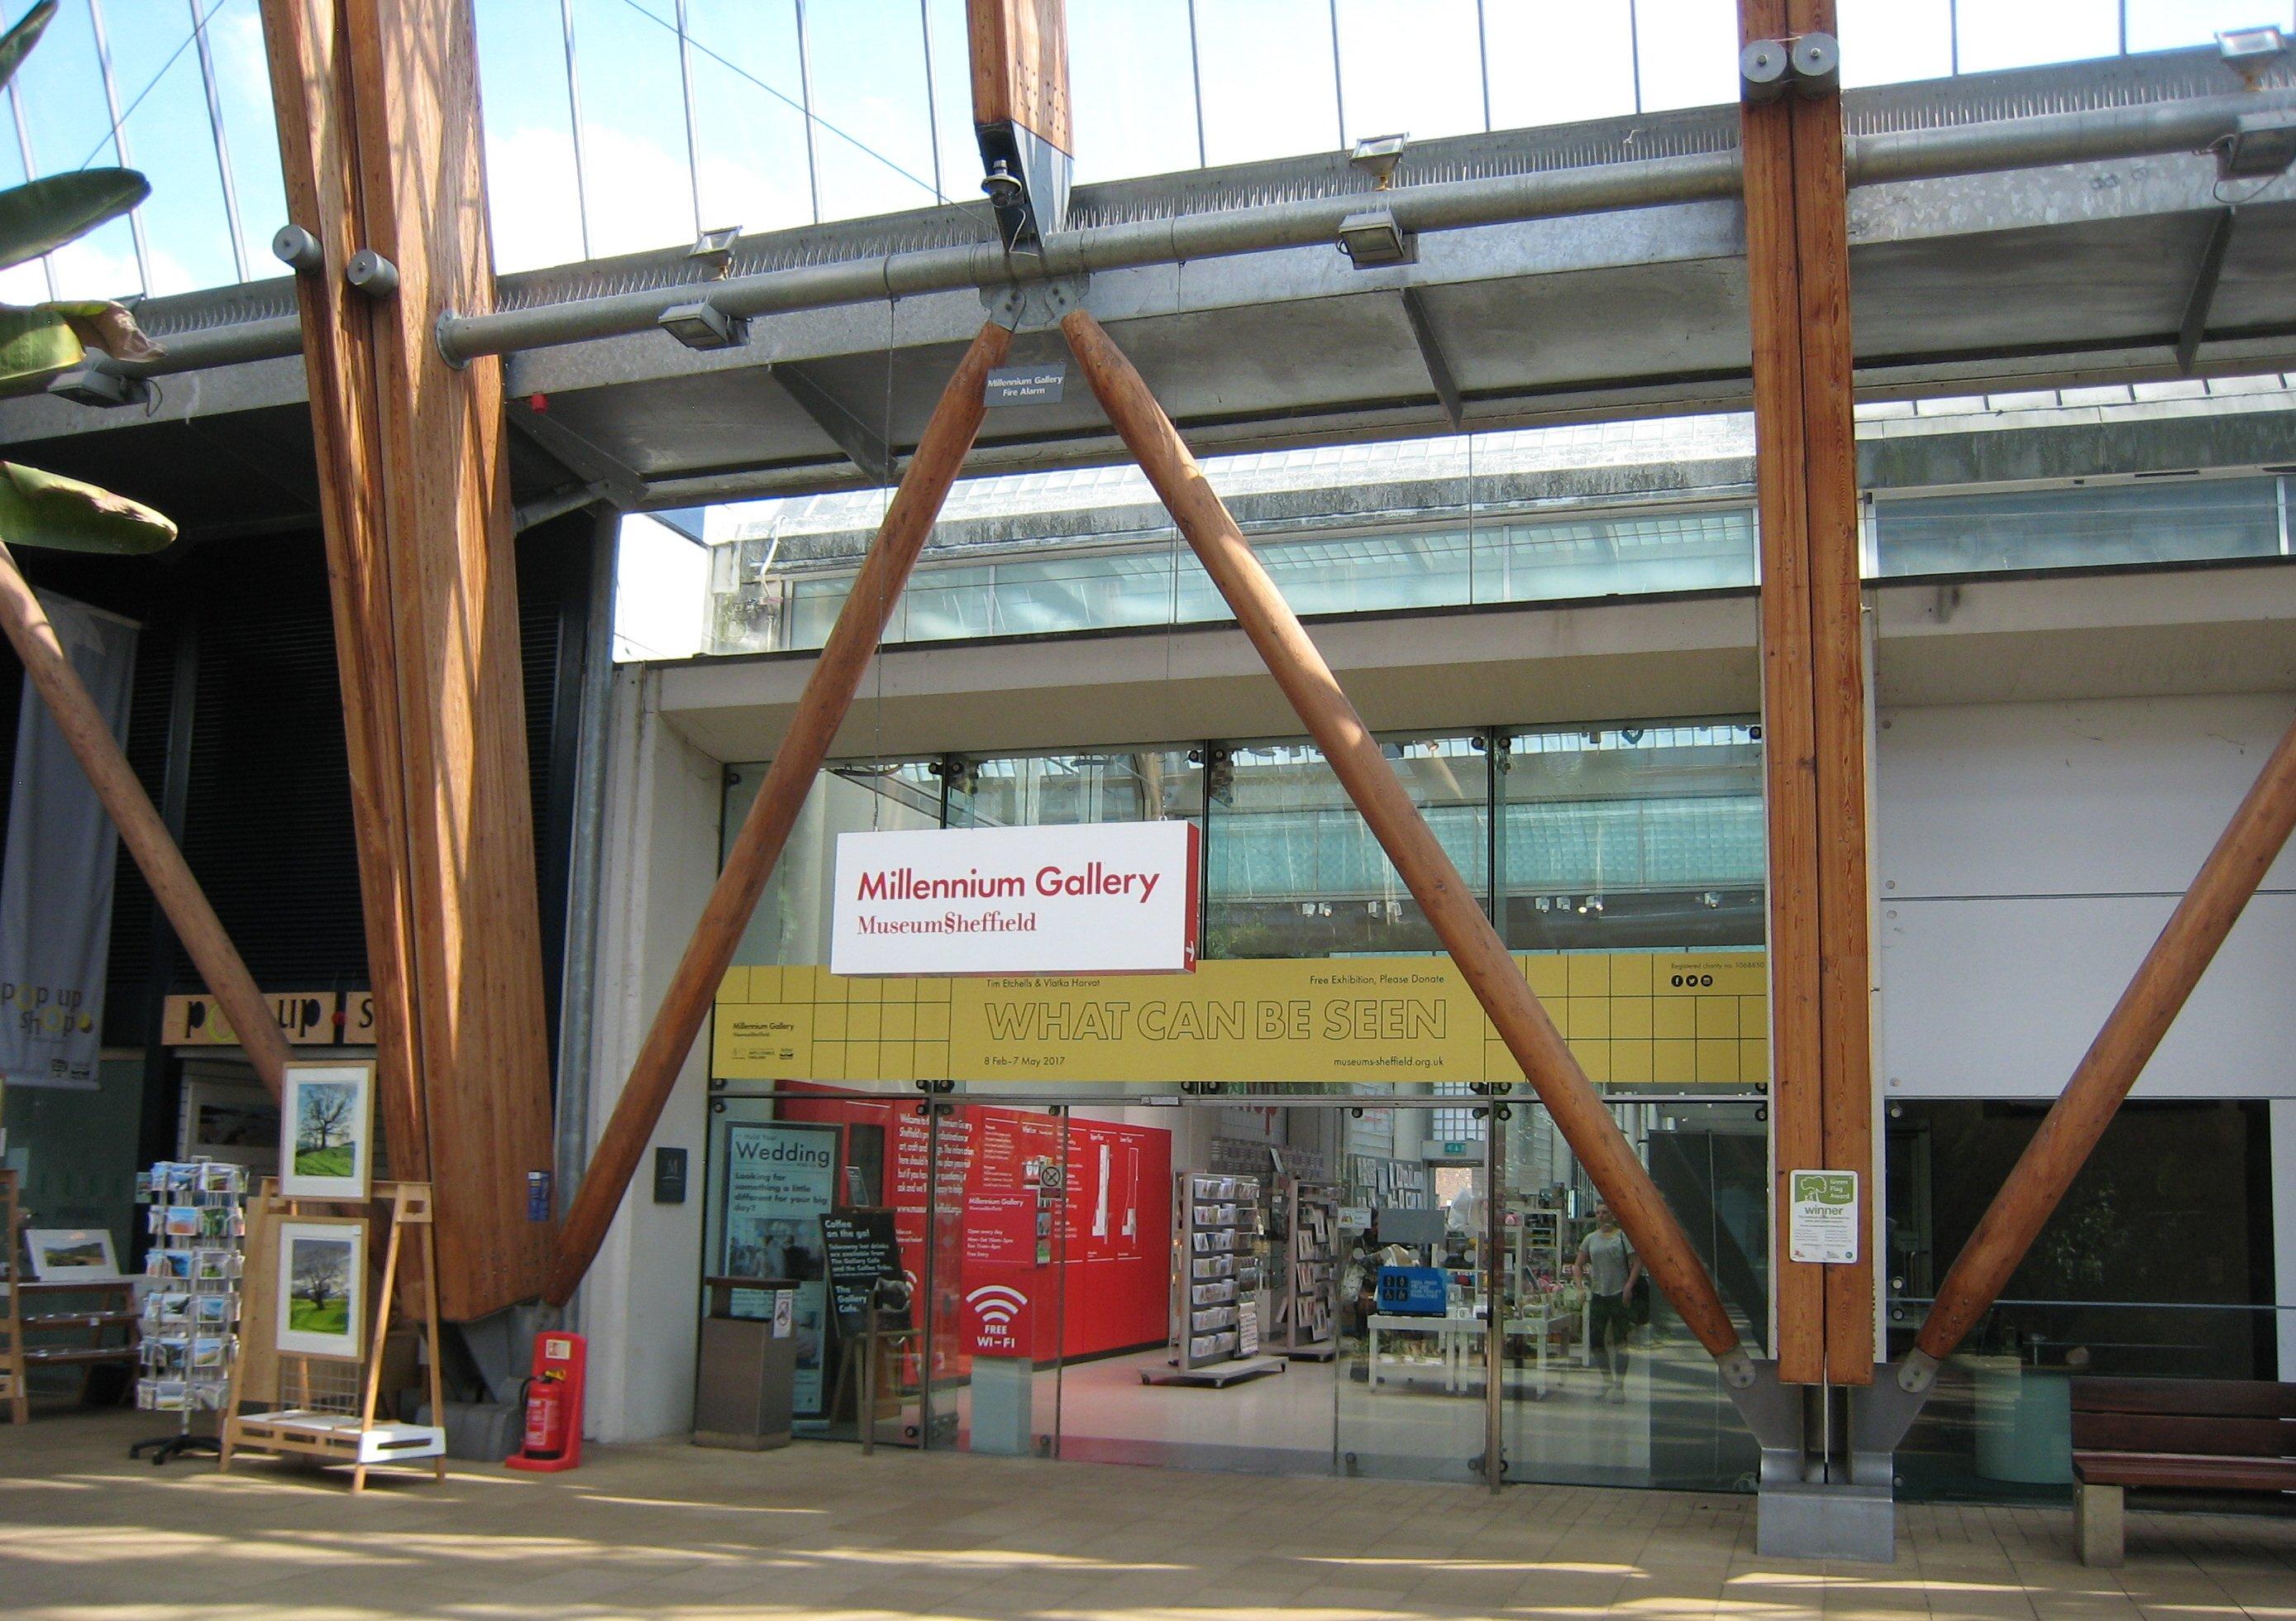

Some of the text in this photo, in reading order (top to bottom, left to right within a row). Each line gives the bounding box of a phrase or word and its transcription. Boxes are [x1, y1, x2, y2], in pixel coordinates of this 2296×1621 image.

[988, 375, 1063, 387] Millennium Gallery
[1020, 387, 1045, 395] Alarm
[857, 861, 1160, 903] Millennium Gallery
[986, 978, 1100, 987] Tim Etchells & Vlatka Horvat
[1310, 974, 1444, 985] Free Exhibition, Please Donate
[278, 998, 321, 1037] up
[985, 999, 1446, 1040] WHAT CAN BE SEEN
[769, 1022, 794, 1031] Gallery
[984, 1056, 990, 1065] 8
[1021, 1056, 1040, 1067] May
[1043, 1056, 1065, 1065] 2017
[736, 1141, 830, 1168] Wedding
[735, 1173, 785, 1181] Looking for
[813, 1196, 828, 1205] big
[968, 1197, 1024, 1207] Millennium Gallery
[1804, 1206, 1844, 1216] winner
[825, 1219, 852, 1228] Coffee
[840, 1229, 854, 1238] the
[835, 1285, 851, 1293] The
[837, 1294, 866, 1304] Gallery
[985, 1324, 1007, 1335] FREE
[976, 1336, 1015, 1348] WI-FI
